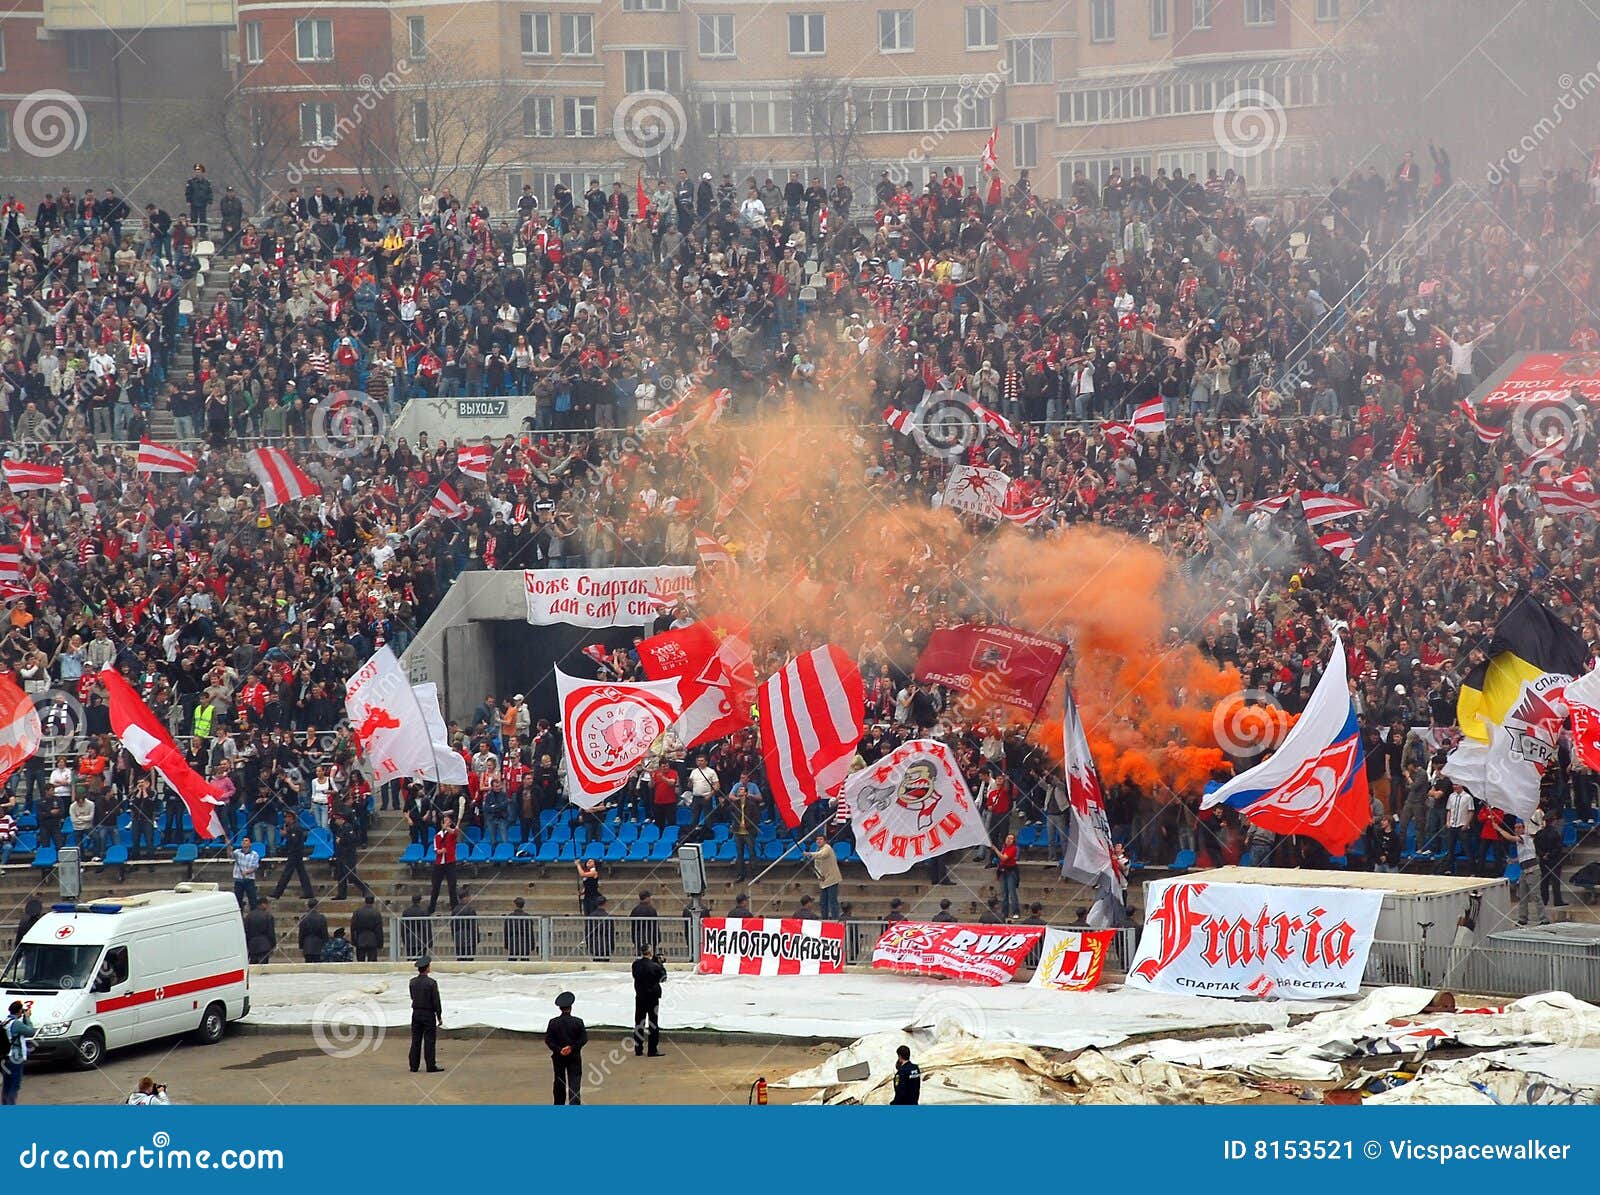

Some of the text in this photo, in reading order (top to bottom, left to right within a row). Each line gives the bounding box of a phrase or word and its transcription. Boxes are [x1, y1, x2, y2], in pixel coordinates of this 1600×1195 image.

[459, 401, 505, 415] ВЫХОД-7
[1486, 389, 1572, 403] РАДО
[588, 707, 625, 759] Spartak
[945, 929, 1027, 955] RWP
[1131, 883, 1357, 983] Fratria
[705, 928, 842, 967] МАЛОЯРОСЛАВЕЦ
[1176, 977, 1240, 991] СПАРТАК
